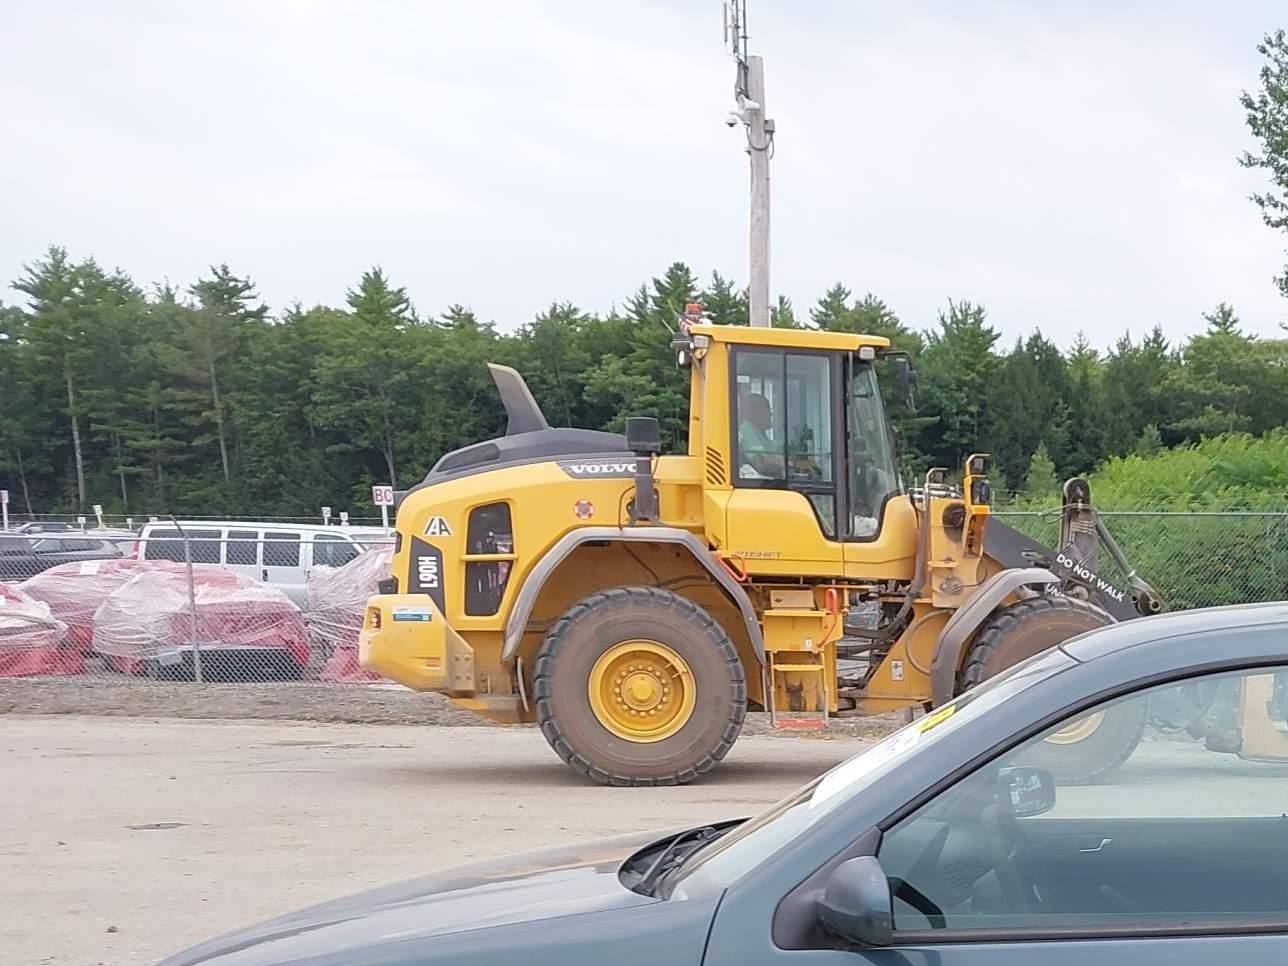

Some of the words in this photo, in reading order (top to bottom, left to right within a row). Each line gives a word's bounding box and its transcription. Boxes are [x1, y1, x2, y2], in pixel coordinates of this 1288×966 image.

[374, 488, 393, 503] BC
[417, 556, 439, 588] L90H
[1056, 553, 1074, 568] DO
[1073, 564, 1097, 583] NOT
[1096, 578, 1125, 602] WALK
